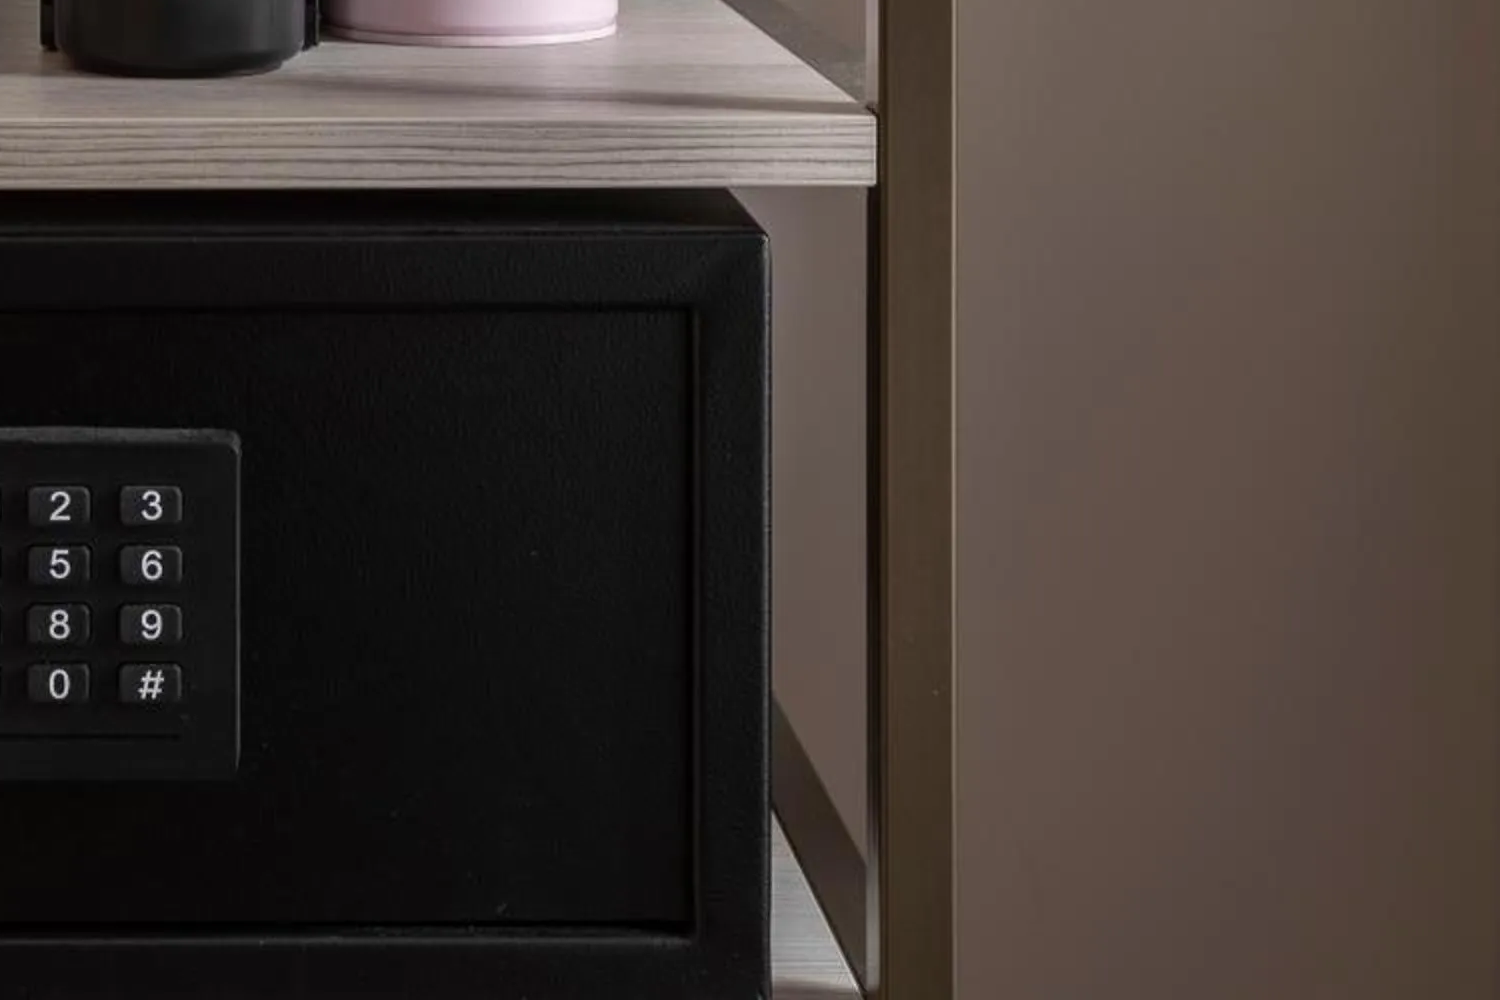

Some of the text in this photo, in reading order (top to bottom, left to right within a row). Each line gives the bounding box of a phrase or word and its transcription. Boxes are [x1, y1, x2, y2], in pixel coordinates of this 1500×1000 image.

[50, 491, 71, 521] 2
[141, 490, 163, 521] 3
[50, 549, 71, 579] 5
[141, 550, 163, 580] 6
[49, 609, 70, 640] 8
[141, 609, 162, 640] 9
[49, 668, 70, 699] 0
[138, 669, 165, 699] #
